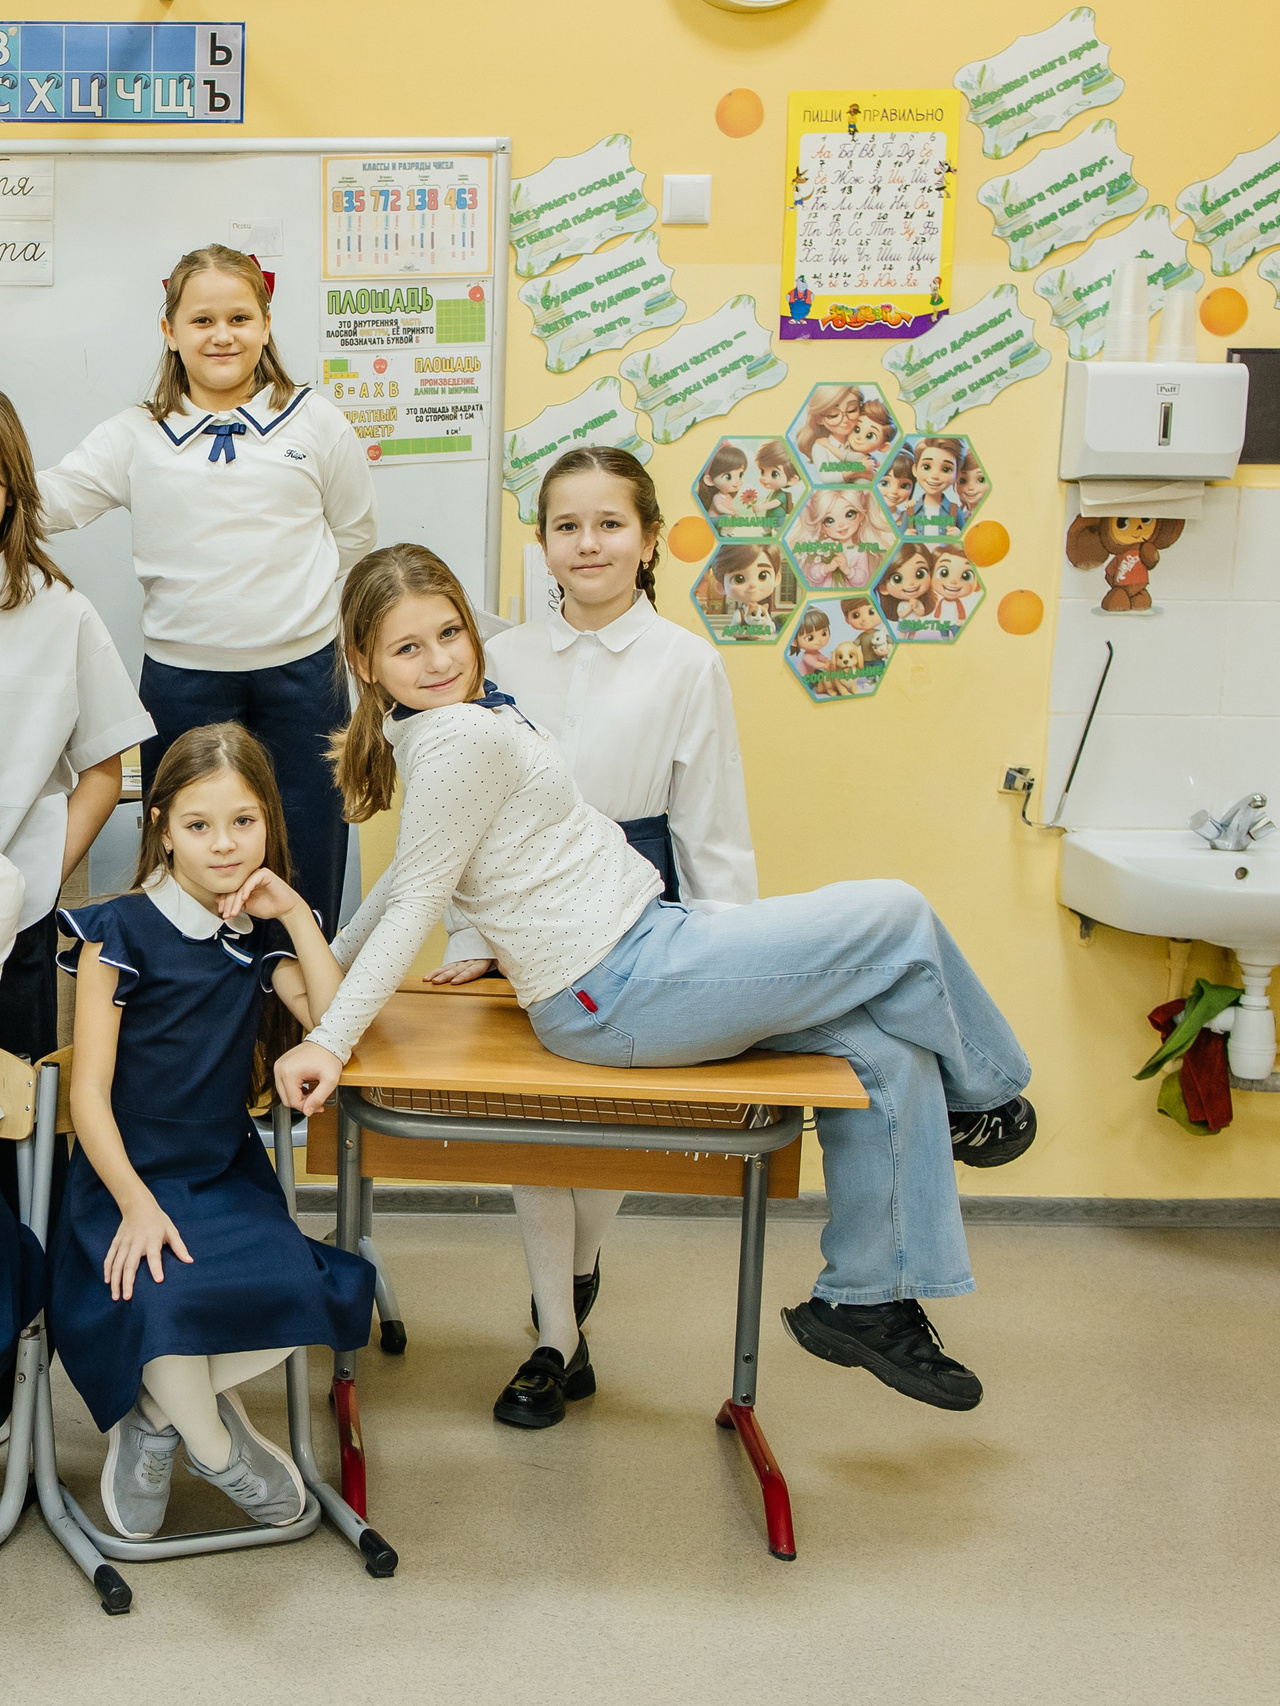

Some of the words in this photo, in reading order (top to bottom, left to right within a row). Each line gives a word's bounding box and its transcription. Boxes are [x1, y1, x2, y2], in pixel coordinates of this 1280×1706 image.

[210, 32, 232, 66] Ь
[971, 75, 1030, 109] Хорошая
[1029, 56, 1068, 80] книга
[1069, 39, 1099, 61] ярче
[1056, 63, 1103, 93] светит
[803, 110, 841, 122] ПИШИ
[864, 108, 944, 121] ПРАВИЛЬНО
[362, 162, 390, 172] КЛАССЫ
[392, 162, 397, 171] И
[398, 162, 431, 172] РАЗРЯДЫ
[433, 161, 454, 171] ЧИСЕЛ
[532, 192, 577, 219] умного
[577, 171, 626, 199] соседа
[1004, 192, 1046, 218] Книга
[1045, 173, 1078, 195] твой
[1080, 156, 1114, 181] друг.
[332, 190, 365, 213] 835
[370, 189, 401, 212] 772
[407, 188, 438, 211] 138
[444, 188, 477, 210] 463
[1010, 225, 1033, 243] без
[1058, 198, 1083, 216] как
[1083, 185, 1105, 203] без
[1106, 172, 1131, 194] рук
[1200, 188, 1241, 216] Книга
[516, 239, 526, 249] с
[527, 218, 572, 245] книгой
[572, 188, 643, 226] побеседуй
[540, 281, 594, 310] Будешь
[595, 258, 646, 286] книжки
[1073, 274, 1112, 301] Книгу
[327, 286, 433, 315] ПЛОЩАДЬ
[541, 310, 591, 335] читать,
[590, 286, 641, 314] будешь
[326, 328, 358, 338] ПЛОСКОЙ
[391, 326, 400, 336] ЕЁ
[402, 326, 434, 336] ПРИНЯТО
[338, 321, 352, 329] ЭТО
[353, 319, 398, 329] ВНУТРЕННЯЯ
[593, 316, 631, 338] знать
[340, 337, 384, 347] ОБОЗНАЧАТЬ
[386, 335, 413, 346] БУКВОЙ
[901, 347, 947, 377] Золото
[950, 308, 1013, 353] добывают
[414, 356, 481, 373] ПЛОЩАДЬ
[648, 362, 690, 389] Книги
[689, 340, 734, 367] читать
[912, 384, 930, 400] из
[972, 355, 982, 365] а
[981, 330, 1023, 359] знания
[334, 382, 345, 400] S
[413, 387, 439, 397] ДЛИНЫ
[447, 386, 479, 396] ШИРИНЫ
[420, 378, 475, 387] ПРОИЗВЕДЕНИЕ
[663, 381, 703, 407] скуки
[702, 374, 720, 389] не
[719, 353, 755, 378] знать
[951, 388, 968, 403] из
[406, 407, 418, 416] ЭТО
[419, 405, 450, 416] ПЛОЩАДЬ
[451, 404, 483, 413] КВАДРАТА
[415, 415, 424, 423] СО
[425, 413, 458, 423] СТОРОНОЙ
[465, 413, 474, 421] СМ
[510, 443, 558, 471] Чтение
[573, 410, 618, 440] лучшее
[819, 460, 866, 473] ЛЮБОВЬ
[718, 516, 778, 528] ВНИМАНИЕ
[792, 541, 843, 554] ДОБРОТА
[722, 625, 771, 638] ДРУЖБА
[899, 619, 950, 631] СЧАСТЬЕ
[802, 663, 886, 686] СОСТРАДАНИЕ
